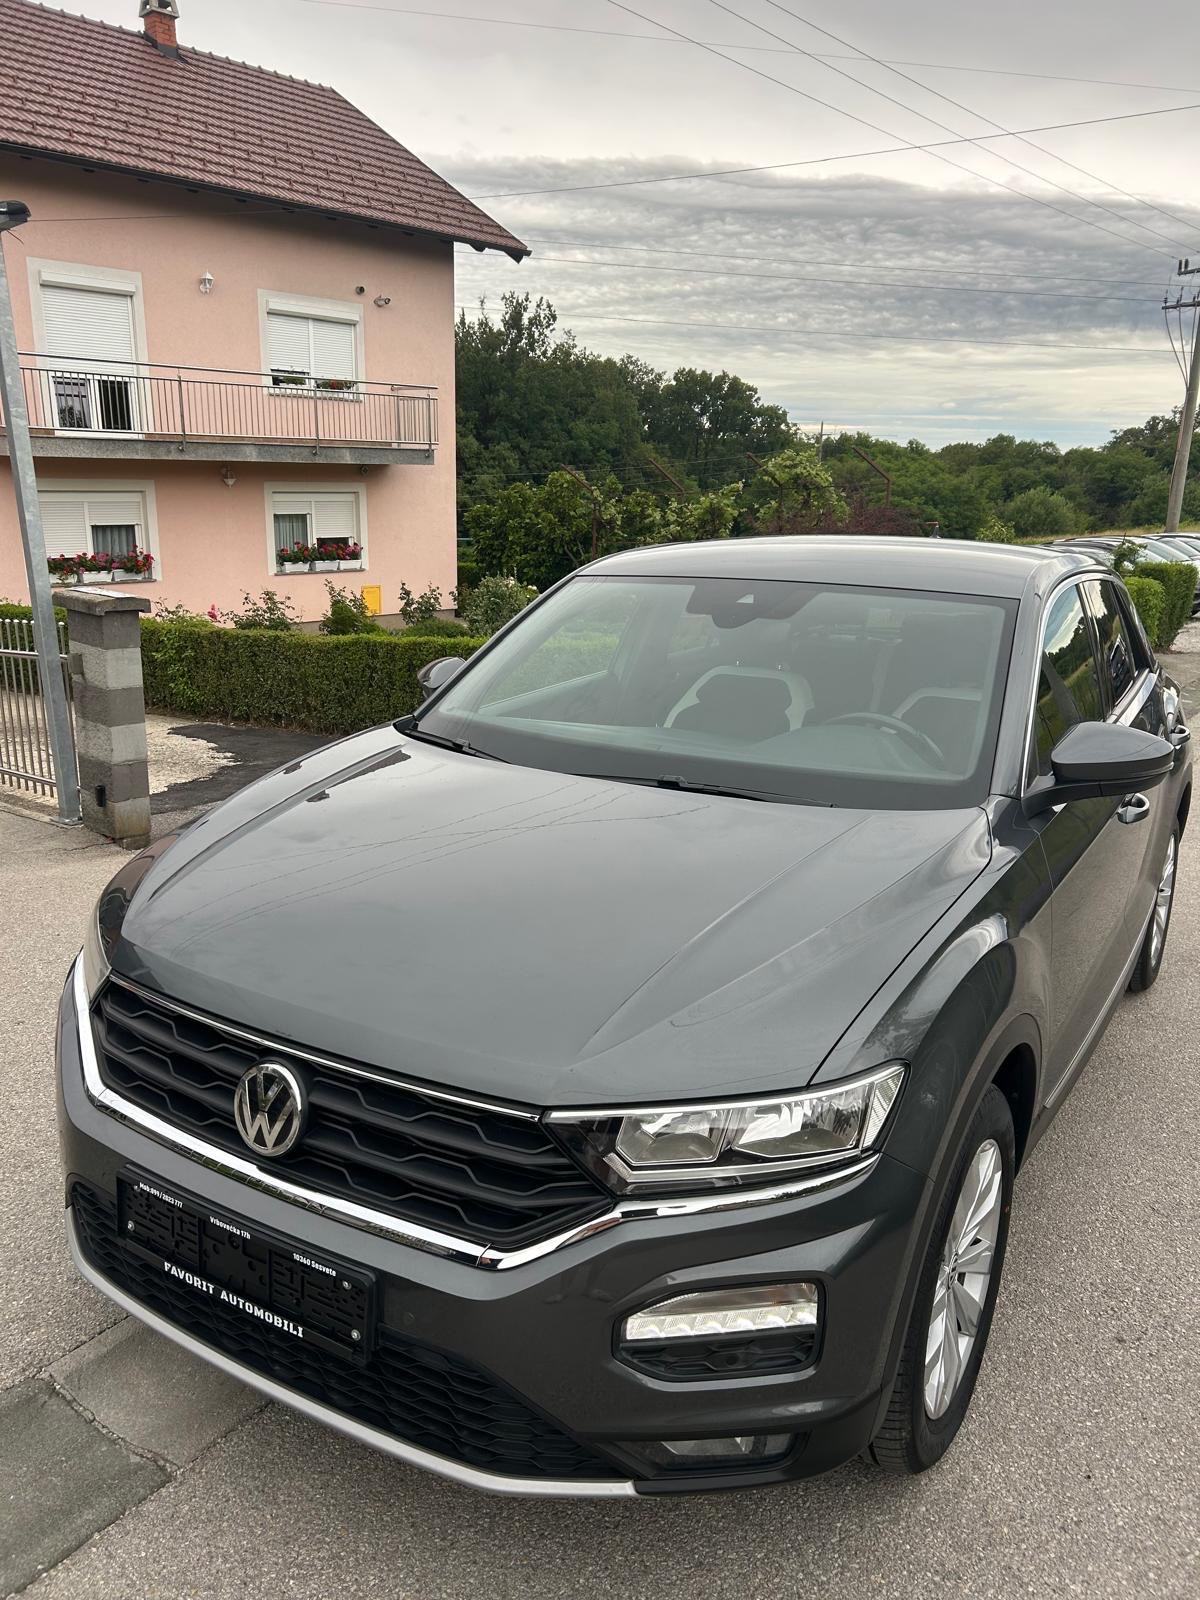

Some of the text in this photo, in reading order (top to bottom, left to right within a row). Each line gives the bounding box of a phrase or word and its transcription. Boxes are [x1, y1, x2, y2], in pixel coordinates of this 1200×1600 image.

[293, 1252, 311, 1266] 10360
[164, 1261, 304, 1338] FAVORIT AUTOMOBILI
